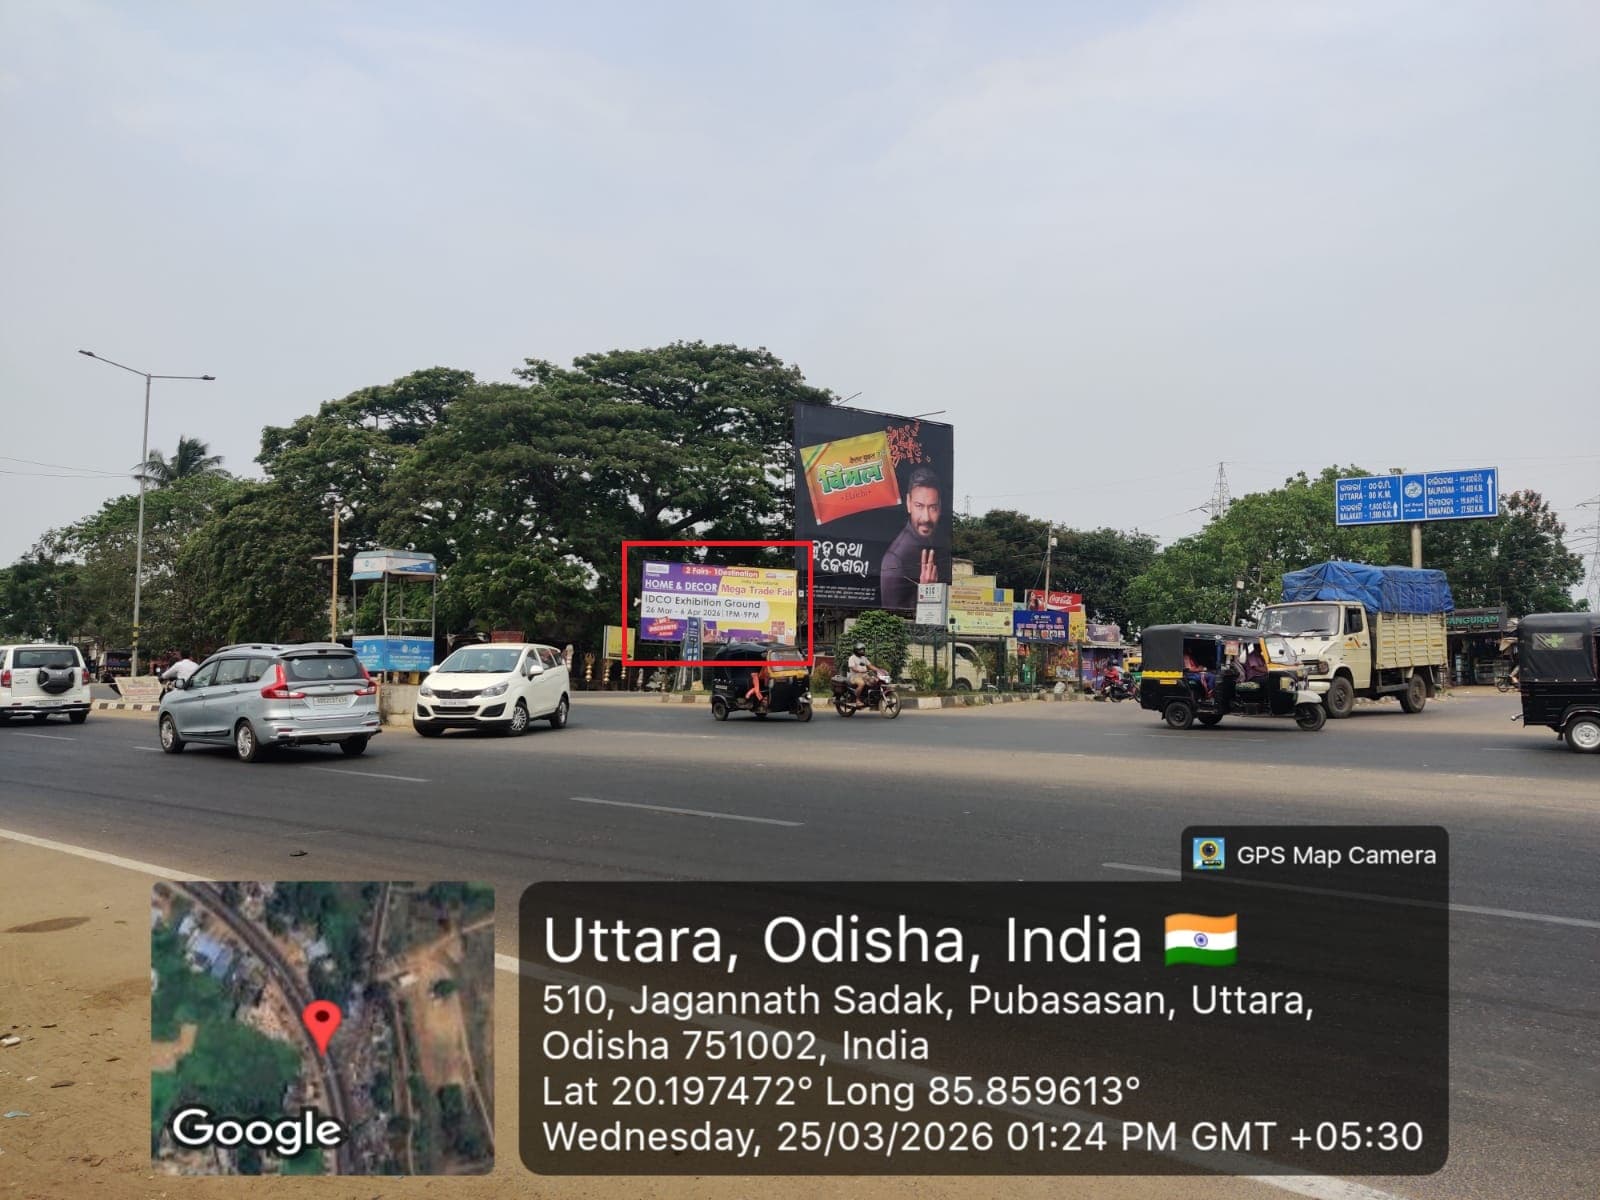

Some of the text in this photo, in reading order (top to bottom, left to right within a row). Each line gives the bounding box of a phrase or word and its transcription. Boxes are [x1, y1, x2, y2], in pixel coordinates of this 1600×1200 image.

[1340, 492, 1363, 501] UTTARA
[645, 579, 718, 592] HOME & DECOR
[721, 584, 794, 596] Mega Trade Fair
[645, 594, 761, 609] IDCO Exhibition Ground
[657, 606, 673, 614] Mar
[1447, 615, 1499, 625] ANGURAM
